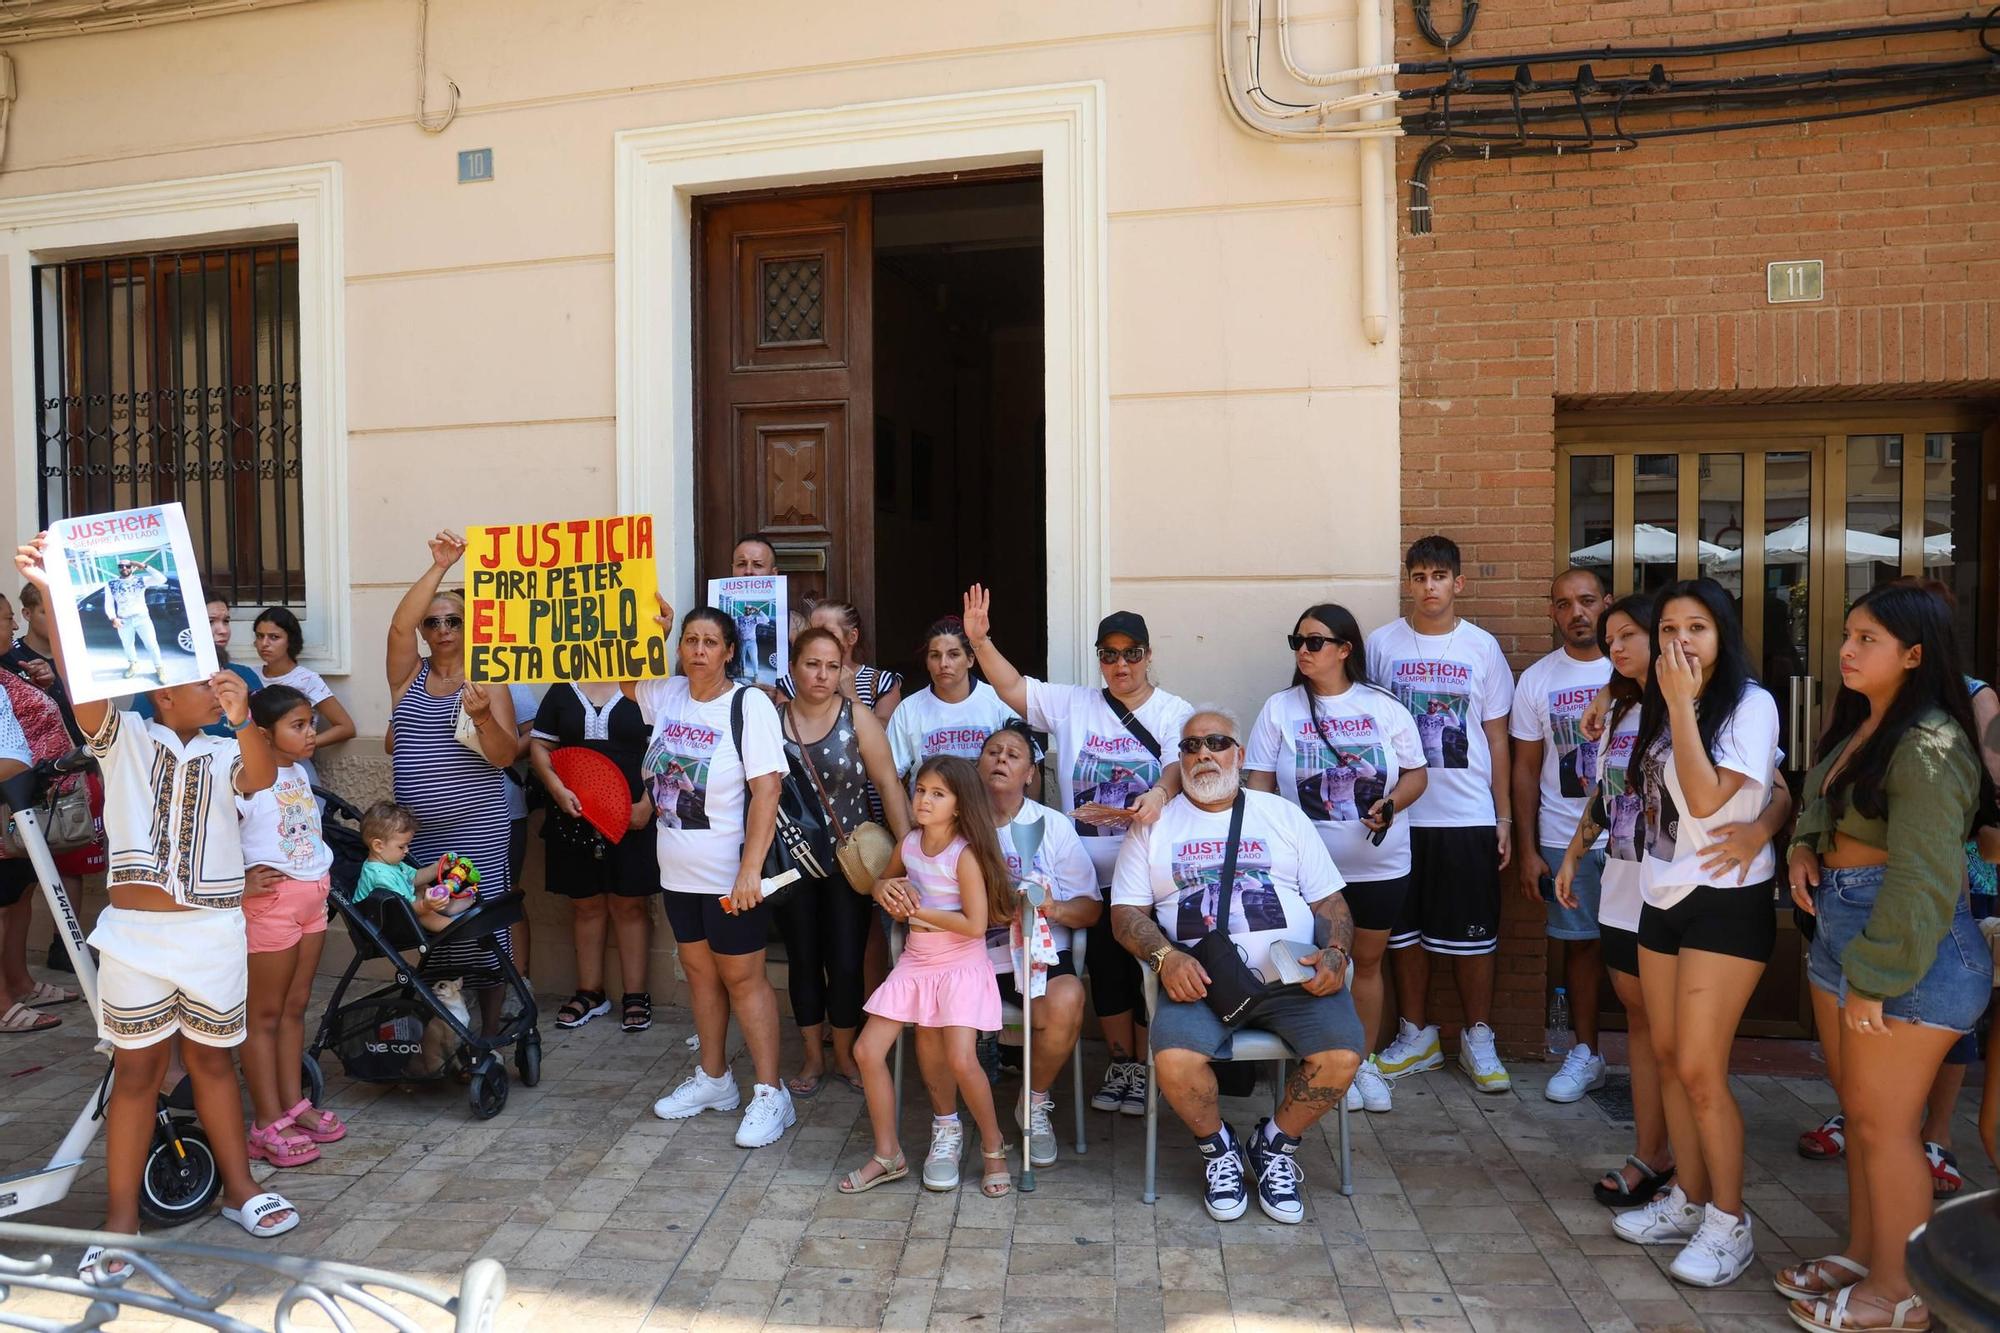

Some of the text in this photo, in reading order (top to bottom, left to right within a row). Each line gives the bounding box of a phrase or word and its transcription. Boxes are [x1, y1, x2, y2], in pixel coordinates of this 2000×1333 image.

[467, 152, 484, 177] 10
[1787, 267, 1803, 296] 11
[67, 513, 161, 540] JUSTICIA
[123, 532, 134, 541] TU
[135, 528, 159, 539] LADO
[480, 516, 653, 569] JUSTICIA
[473, 562, 623, 600] PARA PETER
[722, 580, 773, 590] JUSTICIA
[472, 588, 638, 644] EL PUEBLO
[470, 636, 666, 683] ESTA CONTIGO
[1396, 662, 1468, 679] JUSTICIA
[1447, 677, 1465, 686] LADO
[662, 723, 714, 745] JUSTICIA
[1299, 719, 1373, 735] JUSTICIA
[924, 730, 985, 749] JUSTICIA
[365, 1041, 423, 1055] be cool
